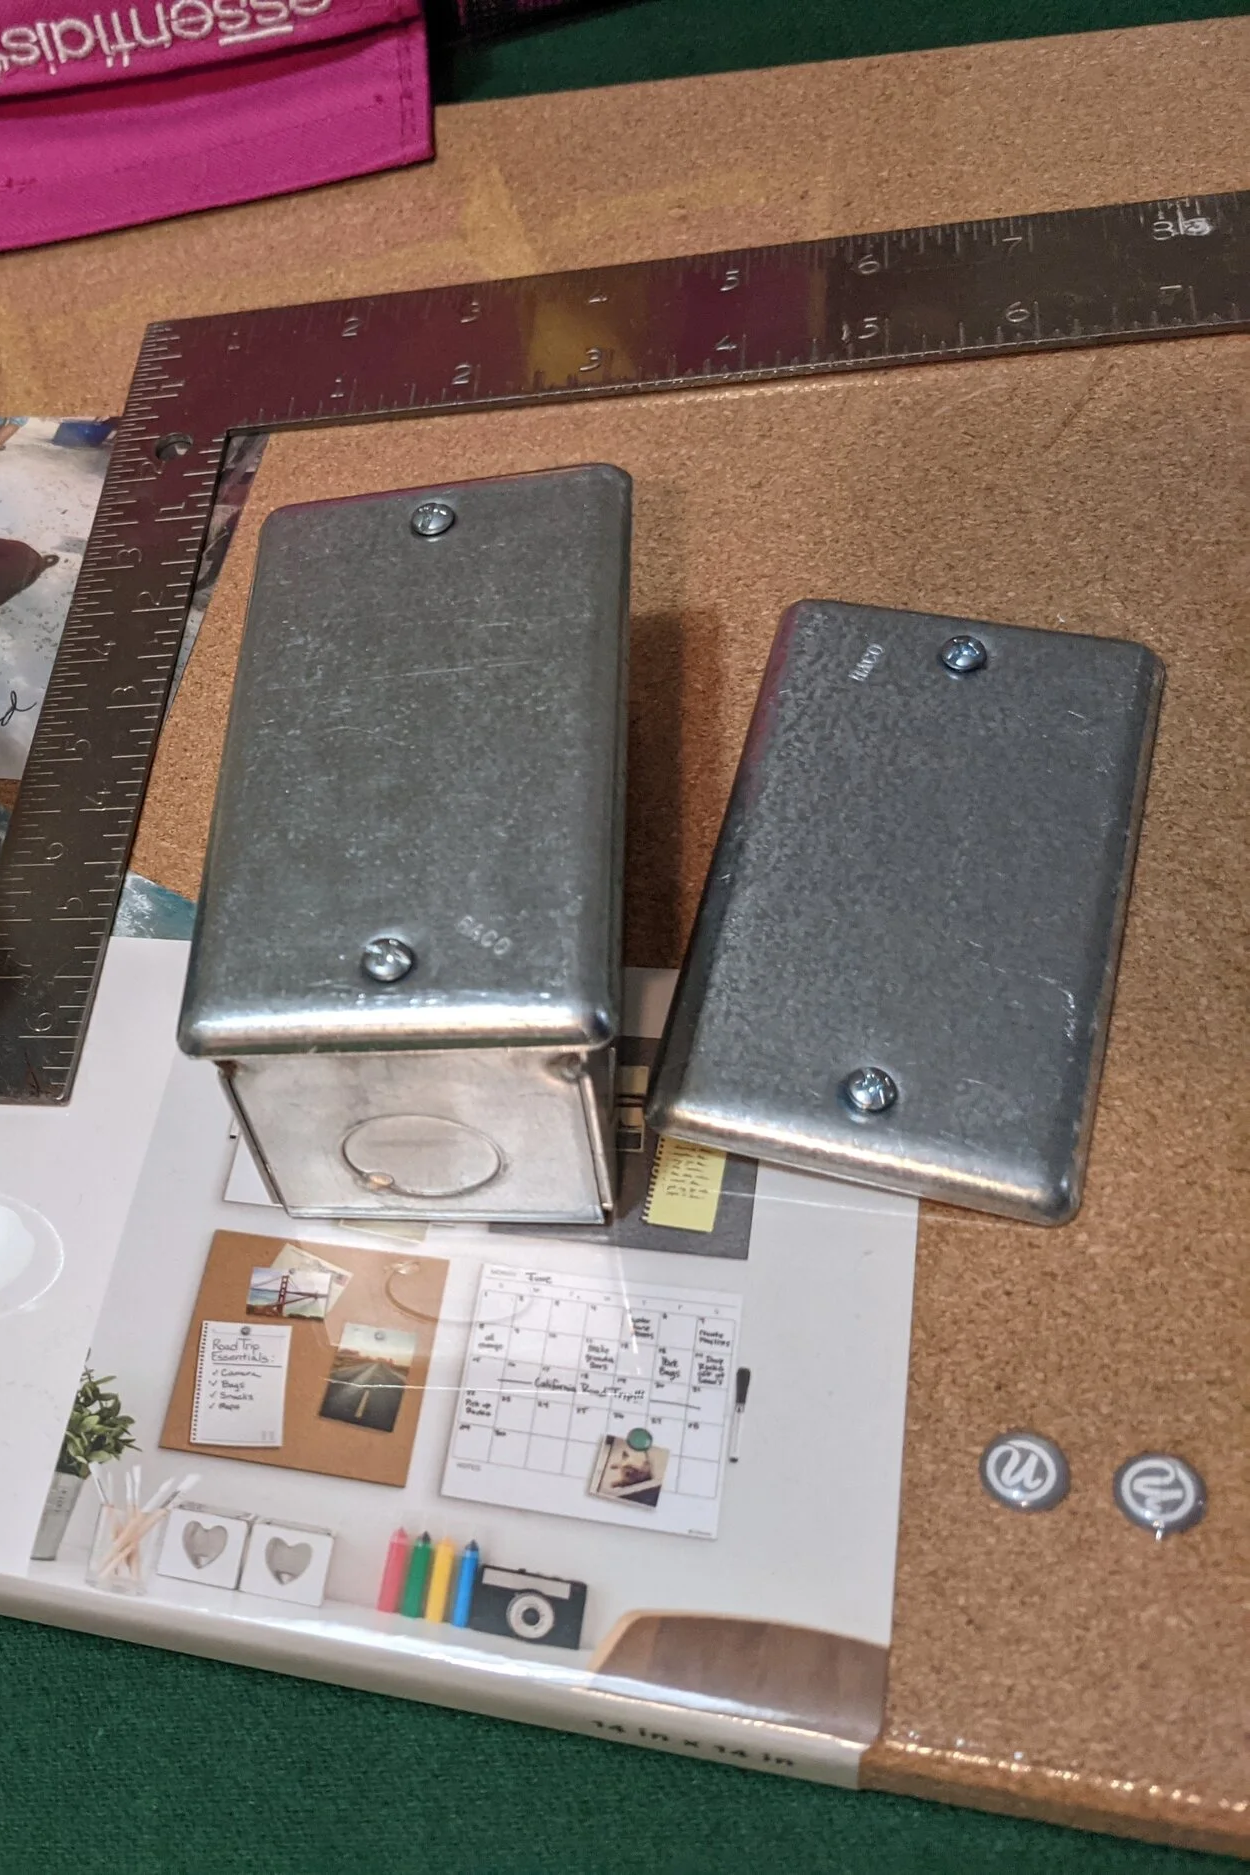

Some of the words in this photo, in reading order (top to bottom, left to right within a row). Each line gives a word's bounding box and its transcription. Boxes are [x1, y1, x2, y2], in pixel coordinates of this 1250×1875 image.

[341, 316, 363, 338] 2
[459, 301, 481, 324] 3
[719, 269, 740, 292] 5
[856, 253, 882, 276] 6
[451, 364, 472, 386] 2
[578, 346, 603, 373] 3
[856, 316, 880, 340] 5
[1004, 301, 1031, 324] 6
[212, 1340, 239, 1352] Road
[239, 1339, 261, 1356] Trip
